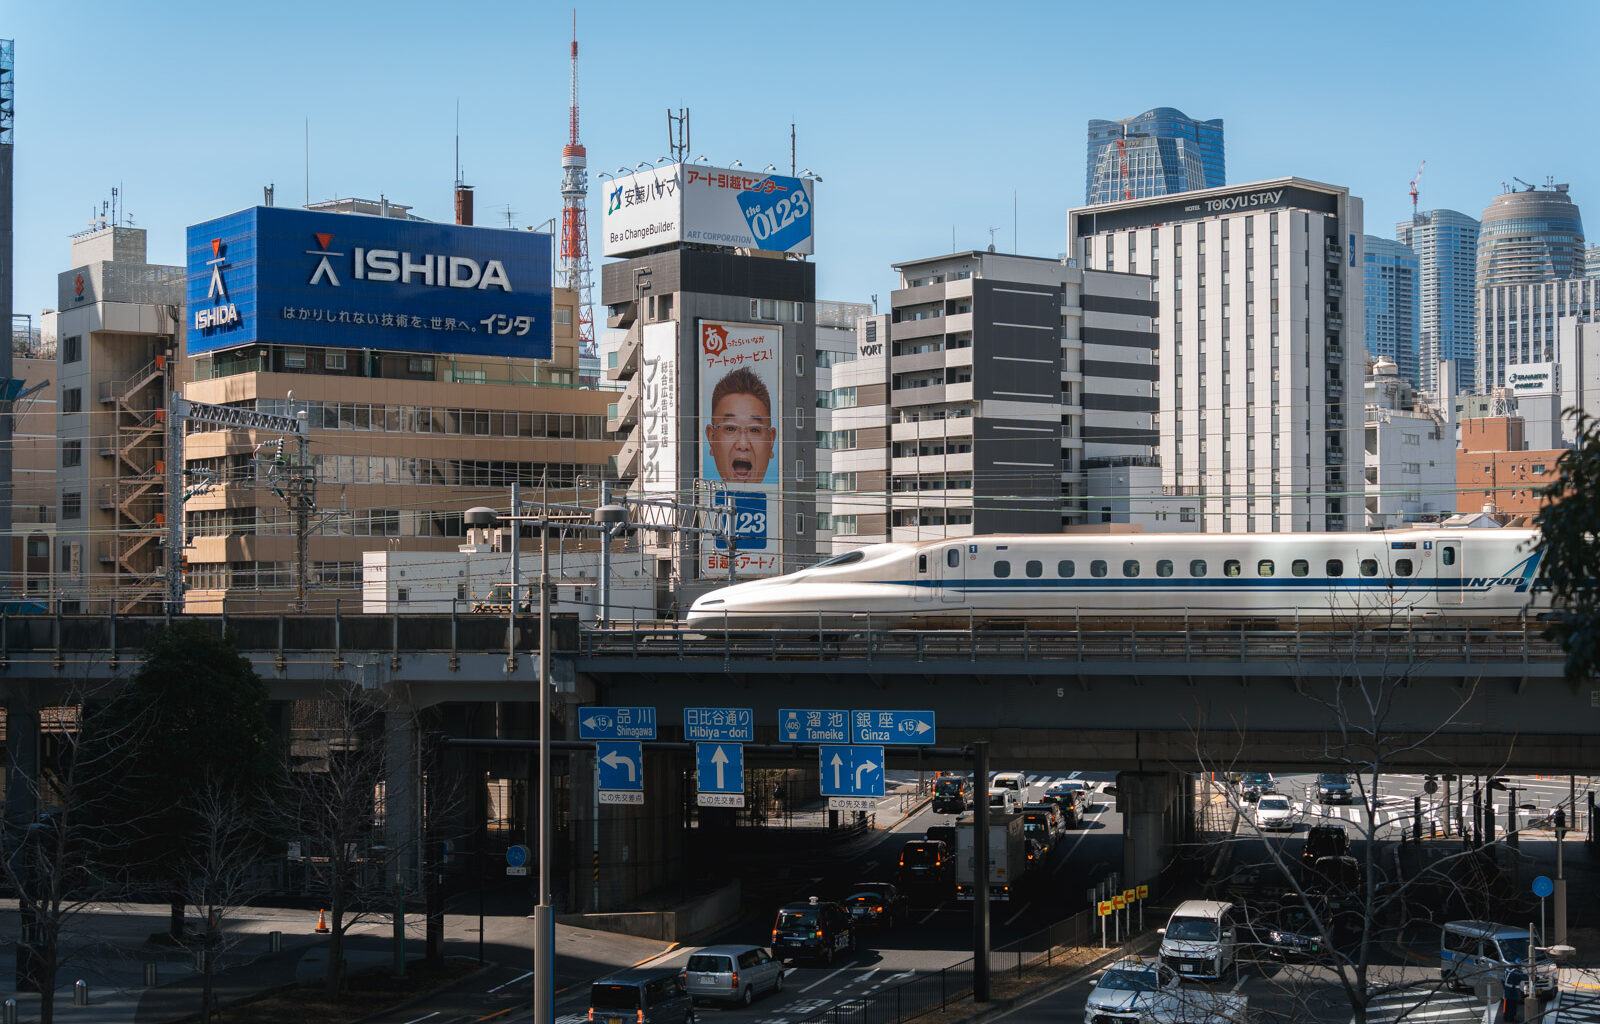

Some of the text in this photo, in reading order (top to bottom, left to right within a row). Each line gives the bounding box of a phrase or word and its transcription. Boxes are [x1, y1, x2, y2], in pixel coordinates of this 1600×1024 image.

[687, 170, 788, 194] アート引越センター
[624, 178, 676, 208] 安藤ハザマ
[1204, 194, 1249, 212] TOKYU
[1250, 189, 1284, 206] STAY
[745, 204, 761, 218] the
[751, 189, 810, 240] 0123
[610, 220, 676, 243] Be a ChangeBuilder.
[686, 230, 752, 244] ART CORPORATION
[354, 247, 513, 292] ISHIDA
[195, 302, 238, 330] ISHIDA
[860, 343, 883, 357] VORT
[706, 348, 773, 369] アートのサービス!
[661, 361, 669, 448] 総合広告代理店
[1057, 687, 1064, 697] 5
[598, 717, 607, 726] 15
[617, 708, 652, 724] 品川
[687, 709, 749, 726] 日比谷通り
[806, 711, 843, 728] 溜池
[856, 712, 894, 728] 銀座
[616, 725, 653, 738] Shinagawa
[787, 721, 799, 730] 405
[903, 721, 914, 731] 15
[689, 726, 748, 740] Hibiya-dori
[806, 728, 844, 741] Tameike
[860, 728, 890, 741] Ginza
[600, 793, 643, 803] この先交差点
[699, 795, 743, 806] この先交差点
[830, 799, 877, 809] この先交差点
